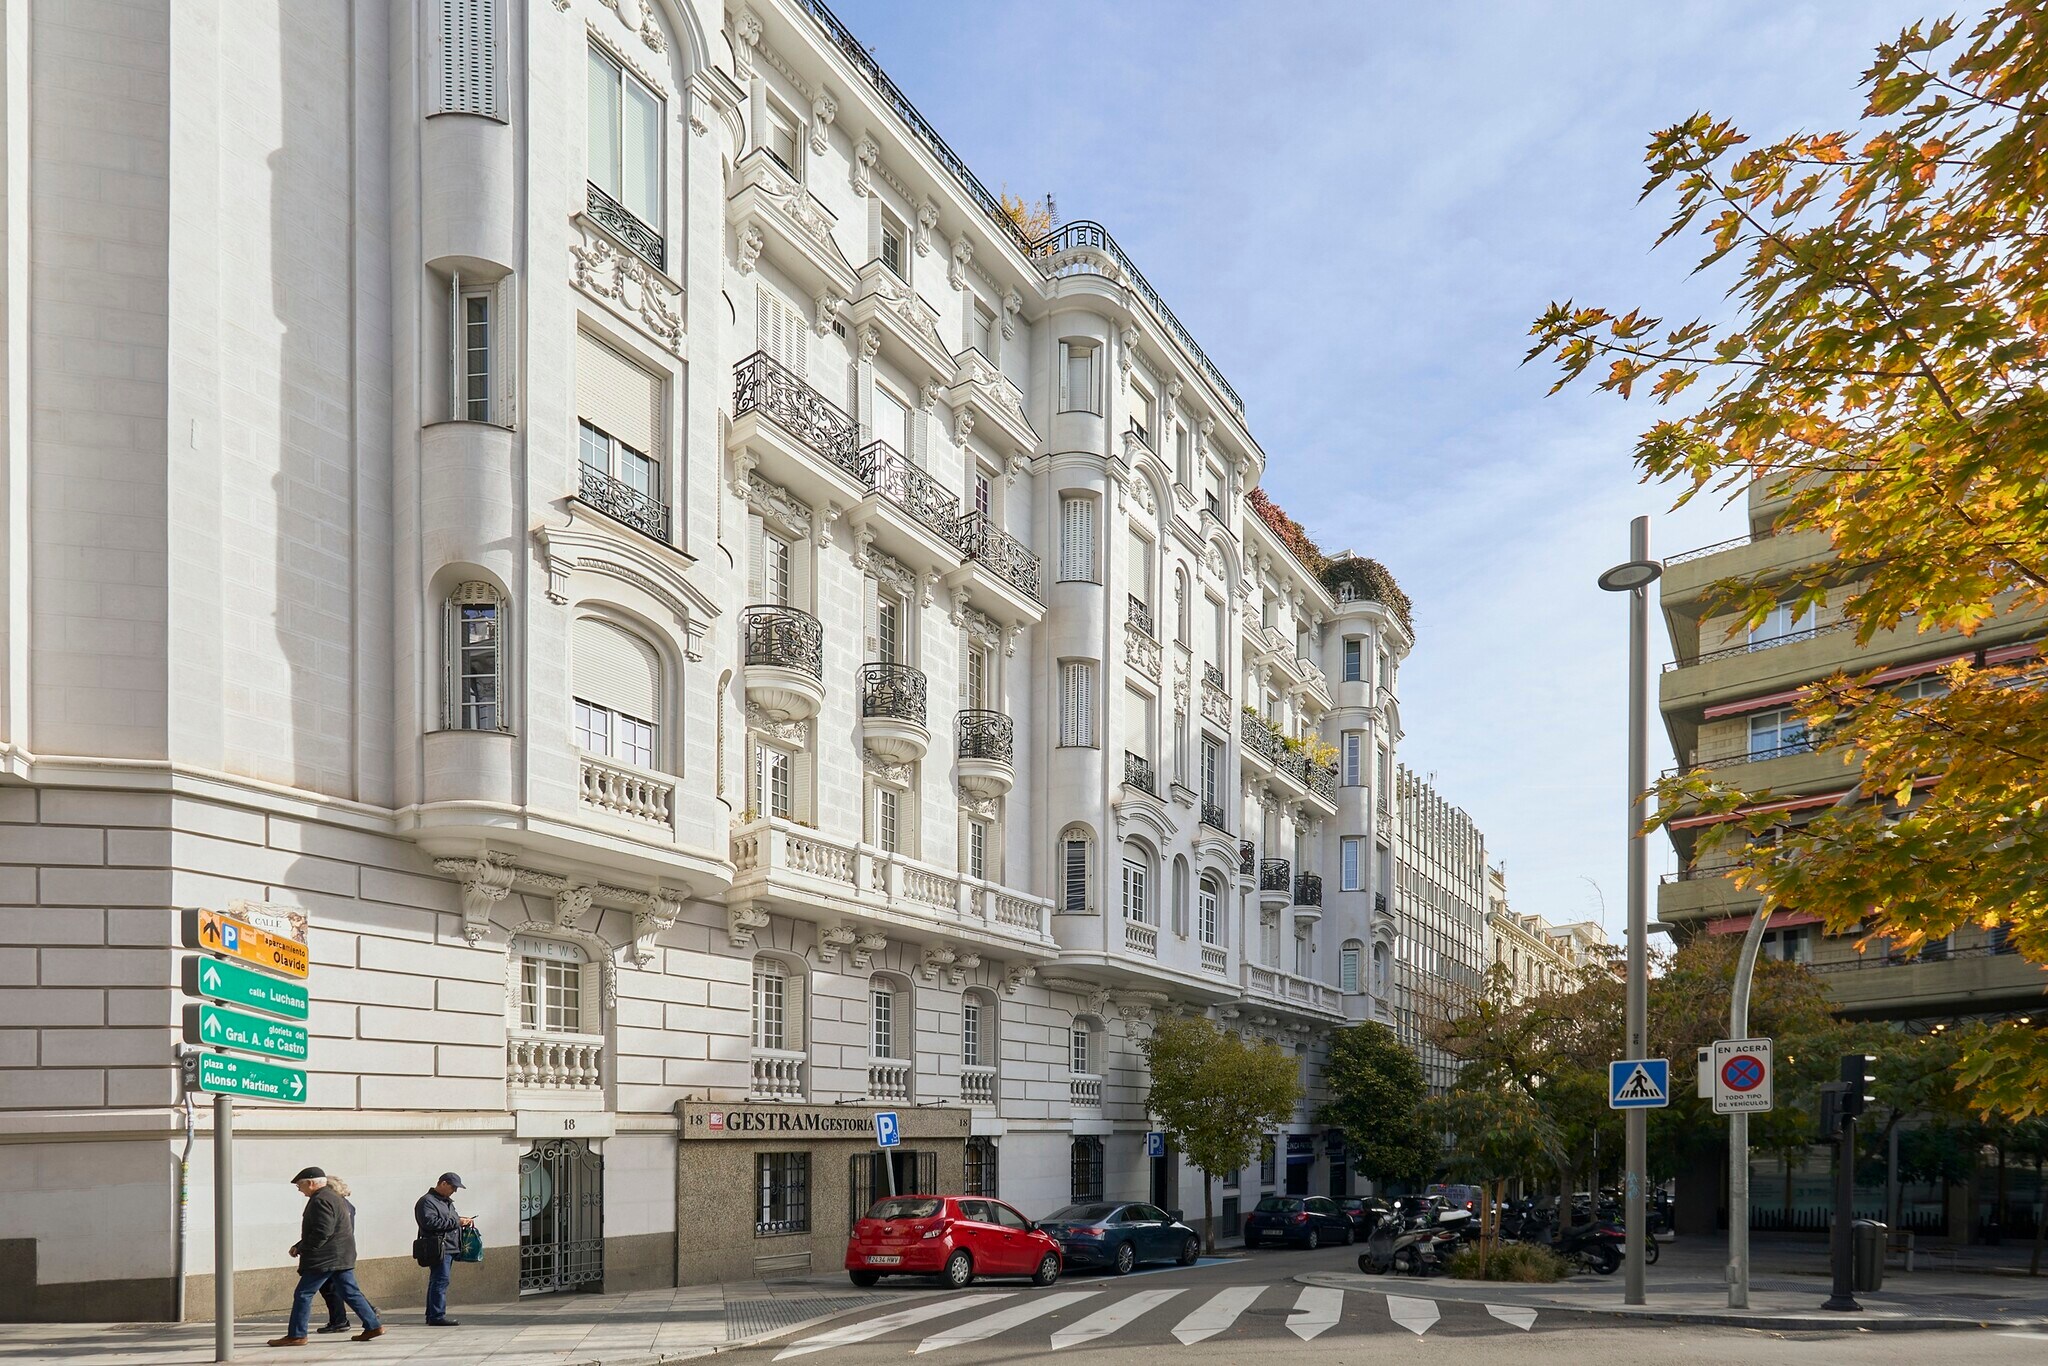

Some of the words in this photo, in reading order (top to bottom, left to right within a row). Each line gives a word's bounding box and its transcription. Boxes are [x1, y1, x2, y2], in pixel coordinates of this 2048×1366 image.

[254, 917, 282, 928] CALLE
[224, 928, 237, 947] P
[264, 937, 305, 957] aparcamiento
[273, 951, 305, 971] Olavide
[249, 987, 266, 999] calle
[269, 987, 305, 1009] Luchana
[225, 1028, 248, 1044] Gral.
[252, 1033, 261, 1046] A.
[264, 1035, 274, 1049] de
[277, 1038, 305, 1054] Castro
[268, 1025, 292, 1038] glorieta
[295, 1030, 305, 1040] del
[1736, 1045, 1768, 1053] ACERA
[203, 1058, 224, 1070] plaza
[227, 1062, 237, 1072] de
[204, 1072, 237, 1088] Alonso
[563, 1118, 576, 1130] 18
[688, 1115, 703, 1126] 18
[726, 1112, 821, 1131] GESTRAM
[879, 1117, 893, 1143] P
[959, 1118, 968, 1127] 18
[1150, 1135, 1160, 1154] P
